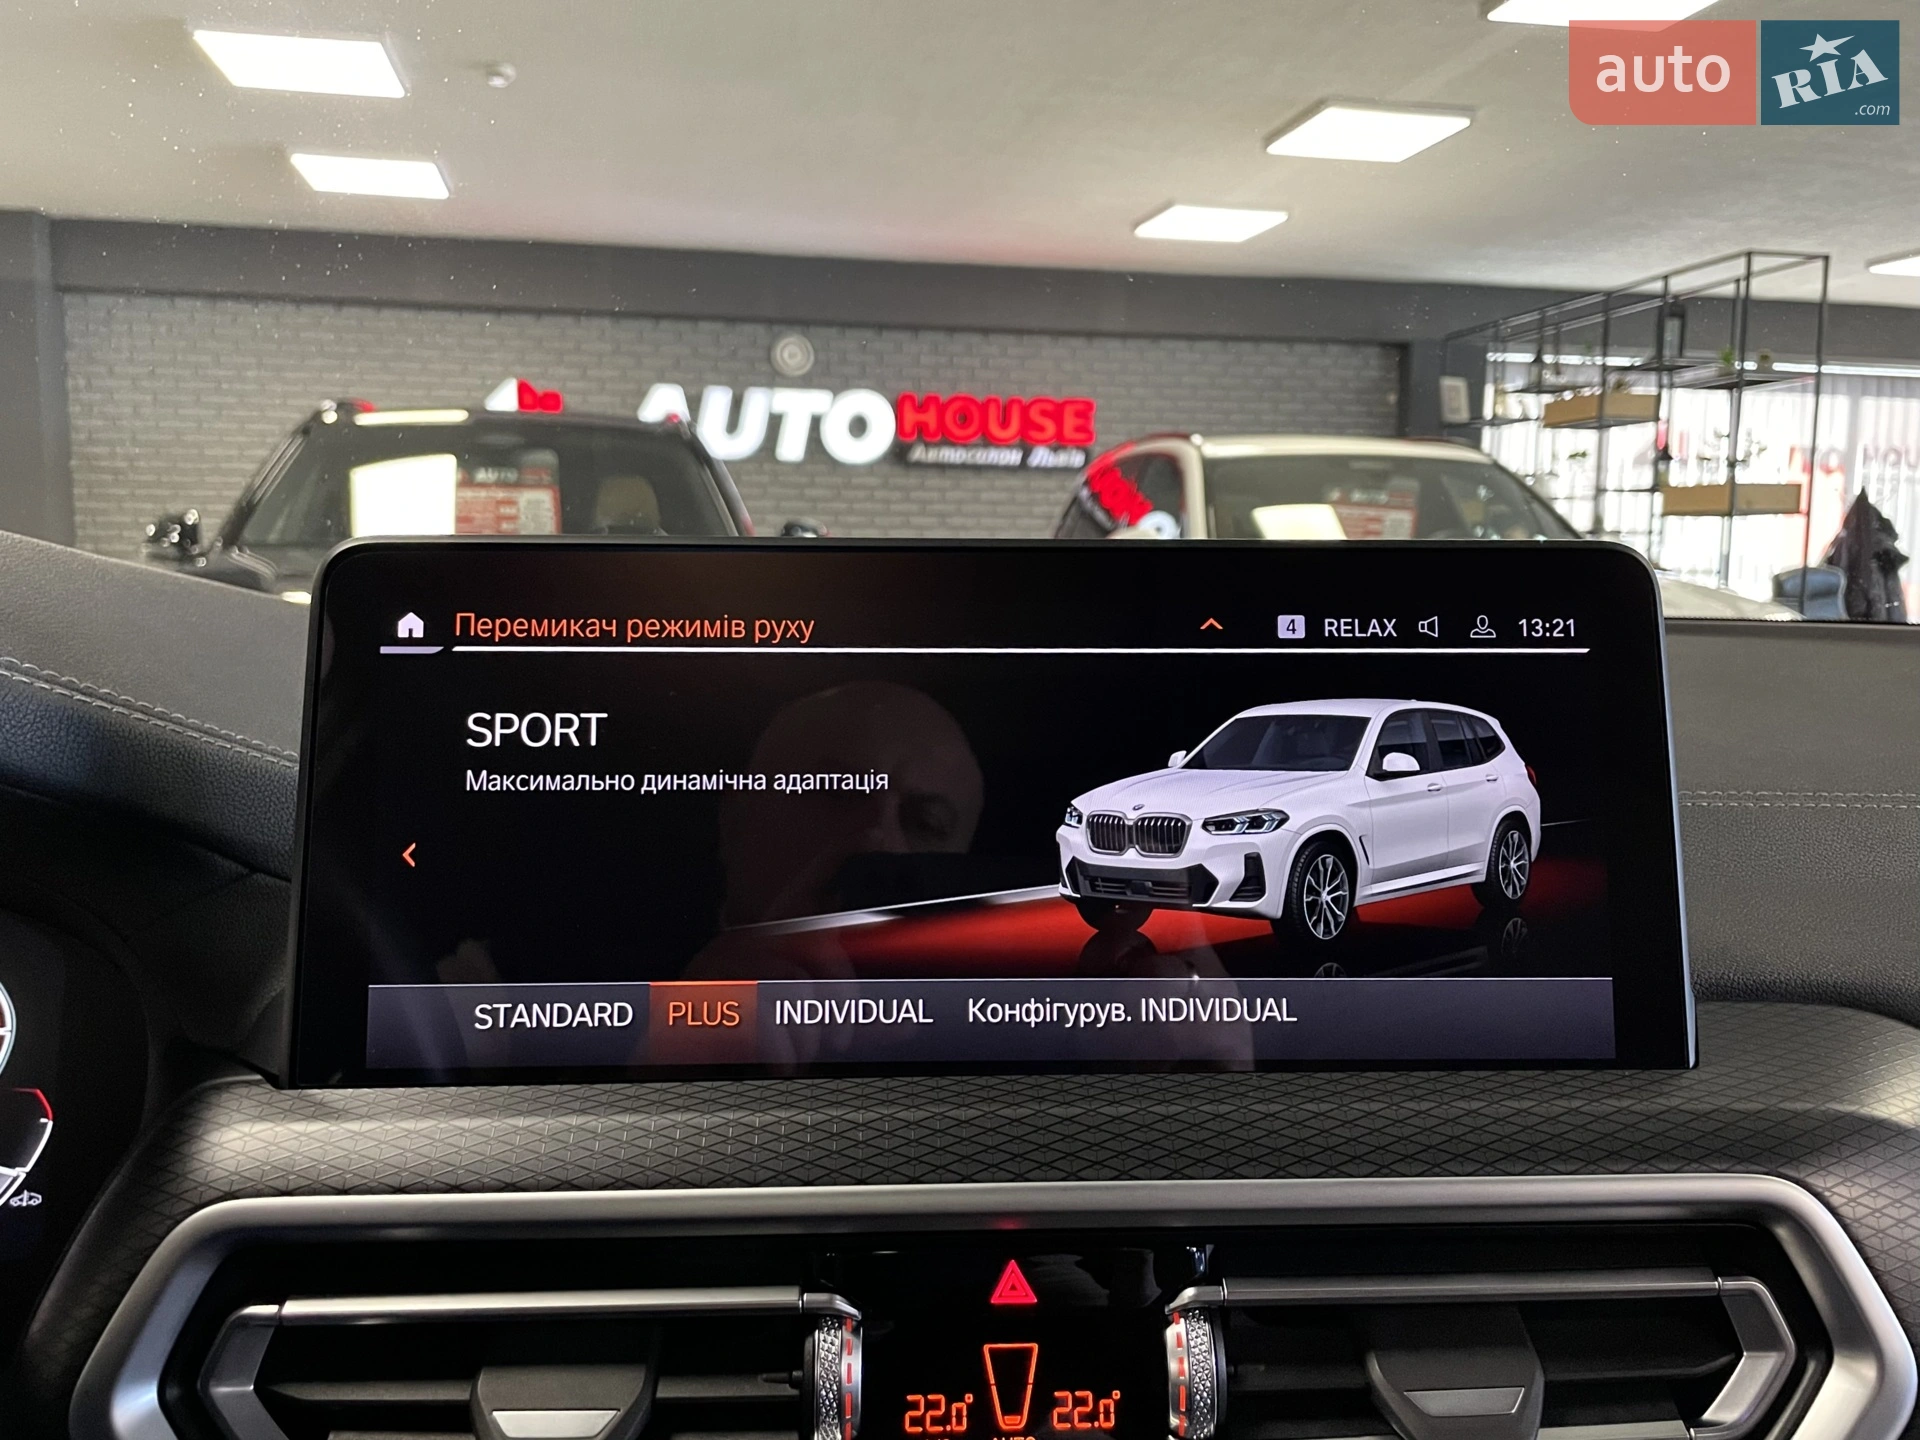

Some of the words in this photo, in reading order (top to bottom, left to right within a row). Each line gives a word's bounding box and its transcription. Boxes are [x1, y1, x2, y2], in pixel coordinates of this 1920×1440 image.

[898, 392, 1096, 446] HOUSE
[456, 613, 616, 641] Перемикач
[628, 615, 745, 642] режимів
[755, 620, 814, 643] руху
[1325, 619, 1397, 636] RELAX
[1519, 619, 1574, 636] 13:21
[467, 713, 608, 747] SPORT
[467, 770, 634, 791] Максимально
[641, 770, 766, 794] динамічна
[774, 769, 888, 794] адаптація
[475, 1002, 633, 1029] STANDARD
[669, 1001, 739, 1025] PLUS
[776, 999, 933, 1024] INDIVIDUAL
[969, 998, 1131, 1027] Конфігурув.
[1142, 998, 1297, 1021] INDIVIDUAL
